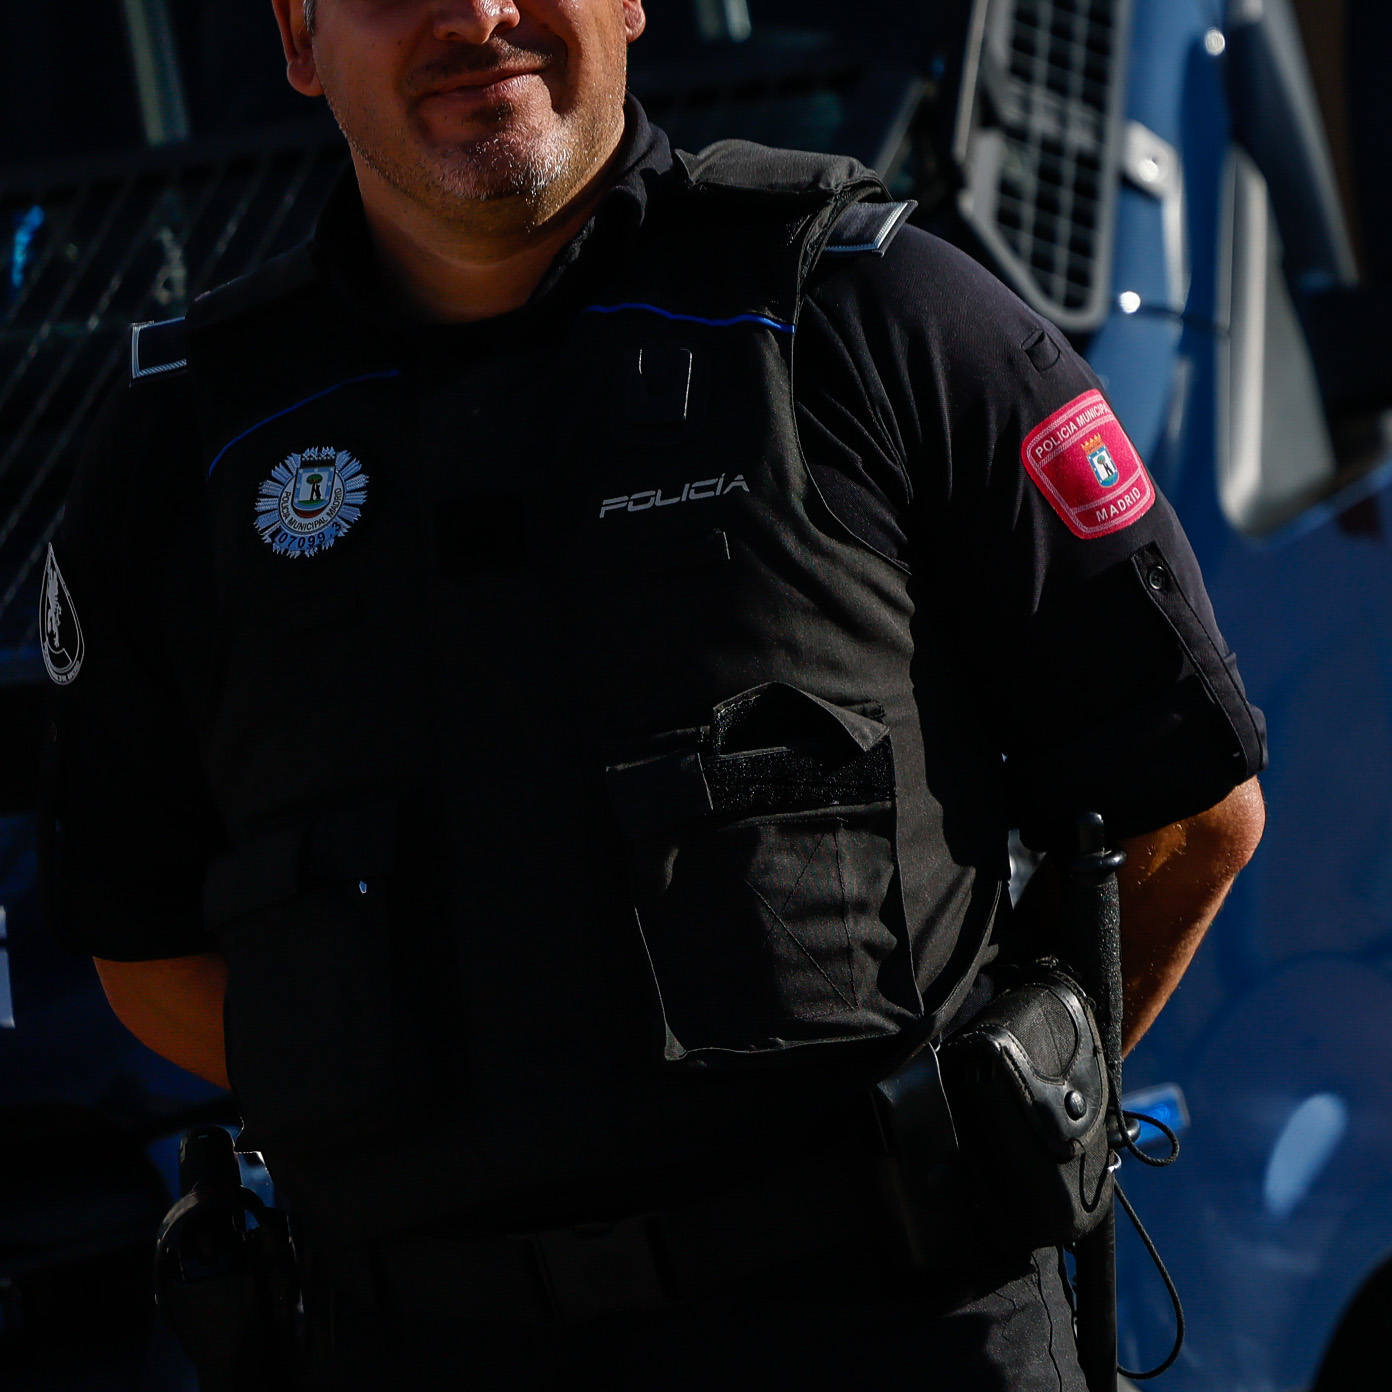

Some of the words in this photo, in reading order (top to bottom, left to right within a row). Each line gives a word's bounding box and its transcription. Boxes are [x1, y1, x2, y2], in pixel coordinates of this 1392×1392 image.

[1034, 422, 1079, 459] POLICIA
[1076, 402, 1111, 428] MUNICIPA
[280, 491, 291, 520] POLICIA
[287, 516, 329, 531] MUNICIPAL
[326, 487, 342, 518] MADRID
[1095, 486, 1142, 523] MADRID
[278, 521, 342, 549] 07099.3
